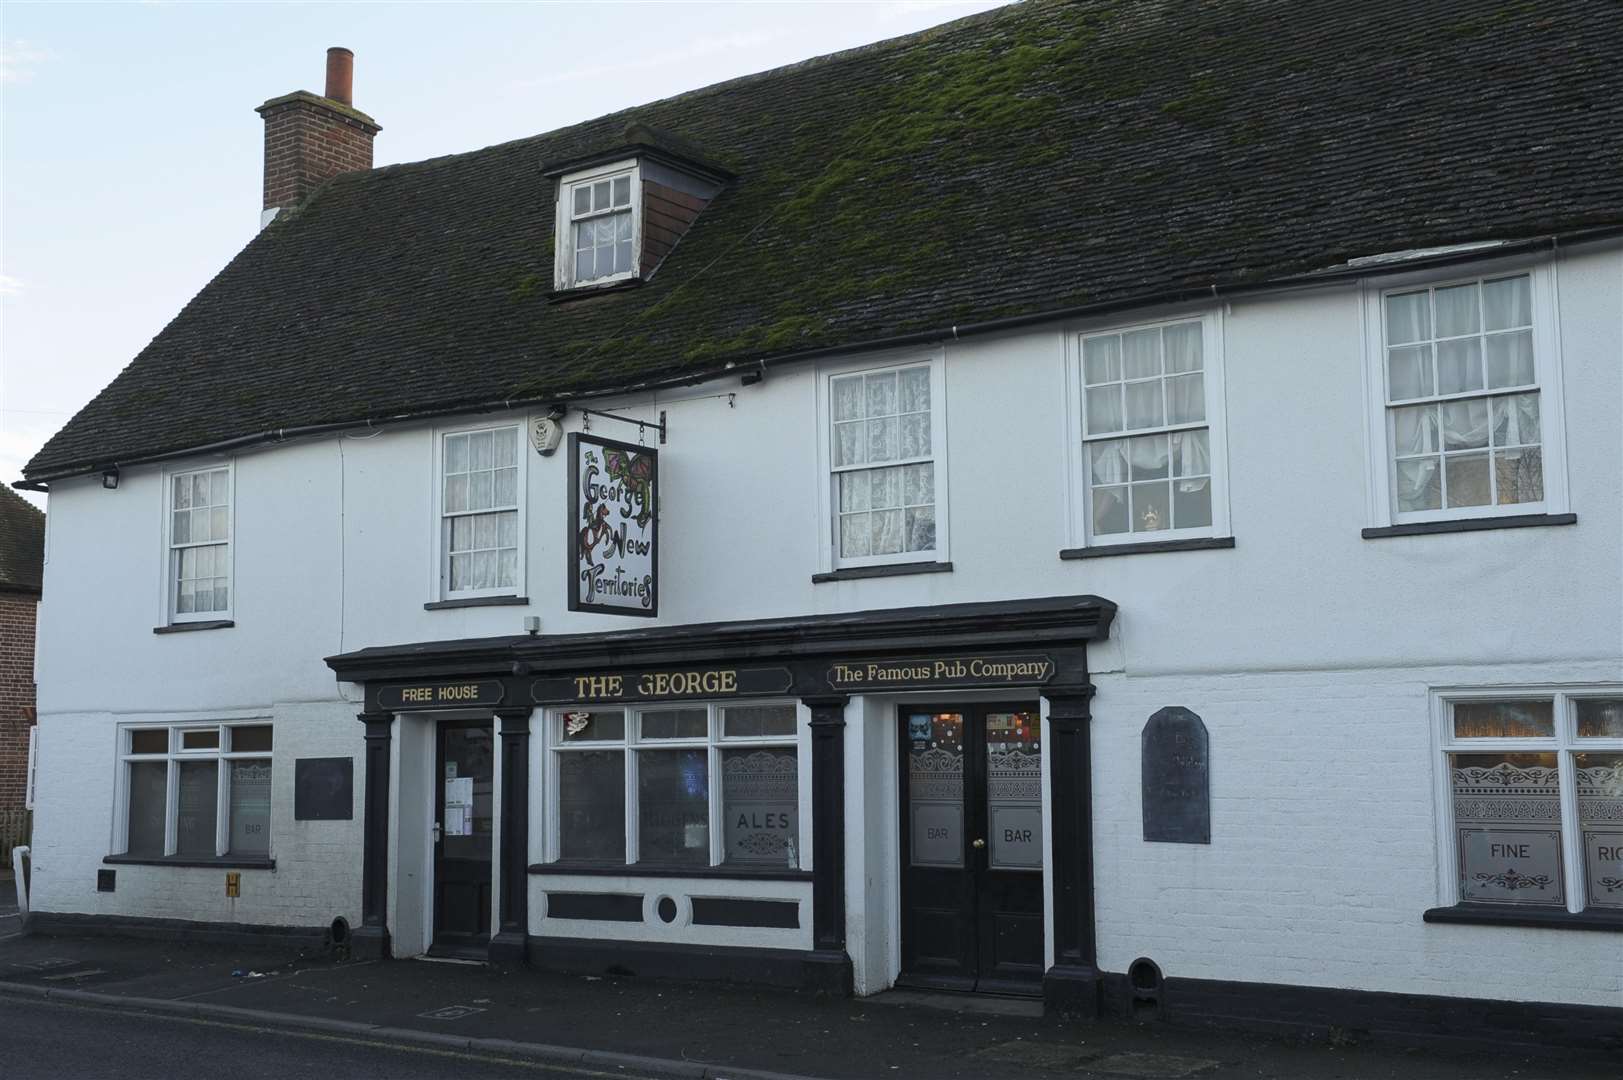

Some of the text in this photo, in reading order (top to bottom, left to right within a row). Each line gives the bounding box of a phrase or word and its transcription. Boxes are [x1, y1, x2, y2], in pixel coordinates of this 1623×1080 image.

[585, 450, 599, 466] The
[582, 465, 645, 519] George
[602, 522, 651, 560] New
[581, 563, 652, 608] Territories
[834, 659, 1049, 682] The Famous Pub Company
[574, 670, 738, 698] THE GEORGE
[402, 685, 479, 702] FREE HOUSE
[736, 812, 789, 829] ALES
[927, 828, 949, 840] BAR
[1004, 829, 1032, 843] BAR
[1491, 844, 1531, 859] FINE
